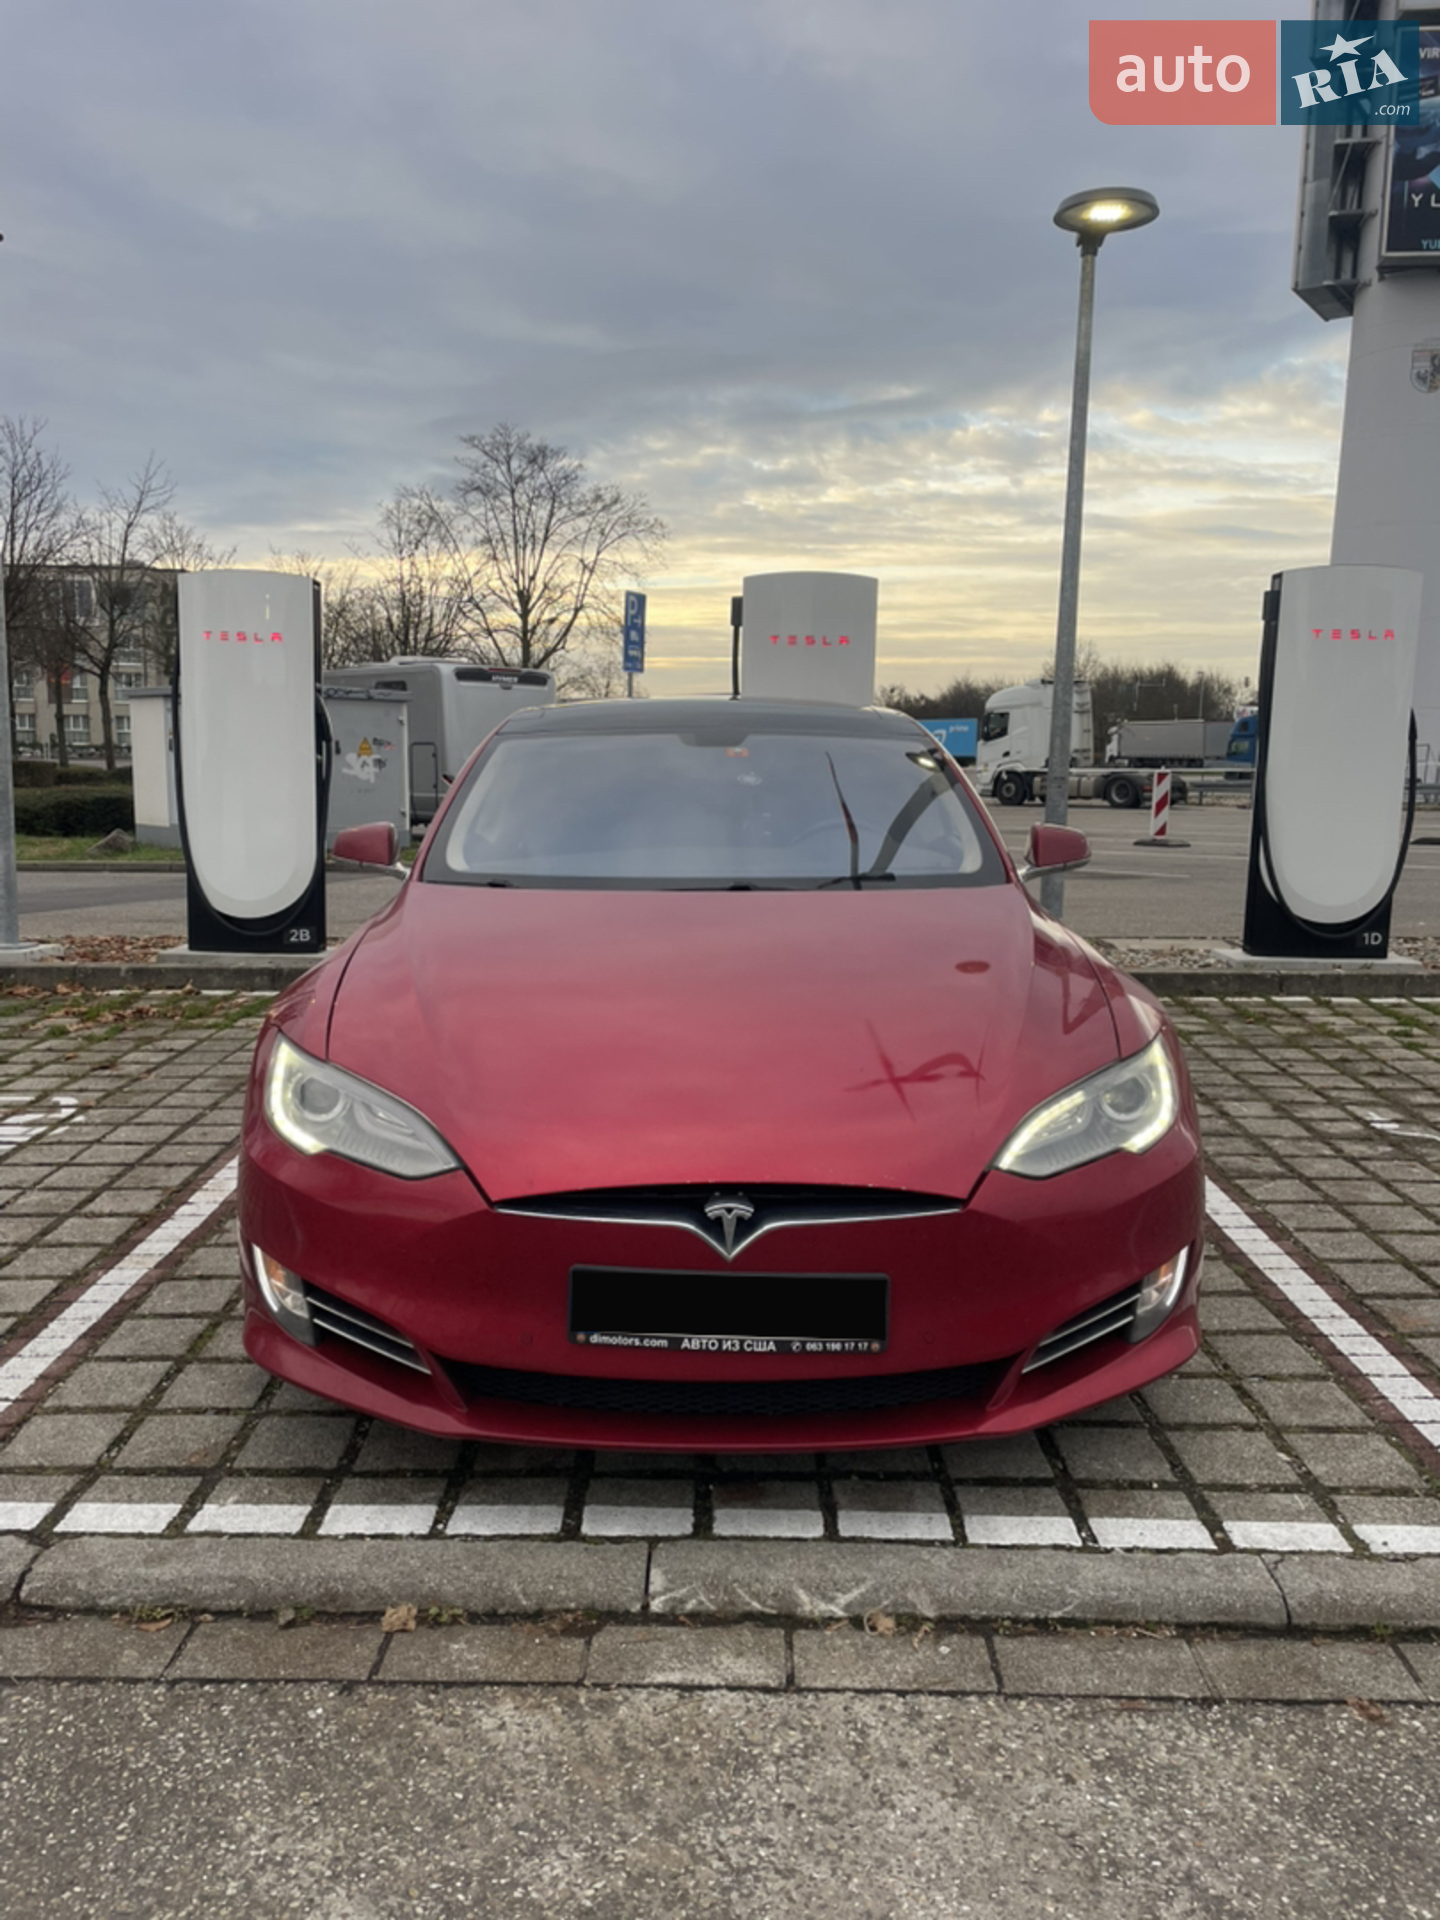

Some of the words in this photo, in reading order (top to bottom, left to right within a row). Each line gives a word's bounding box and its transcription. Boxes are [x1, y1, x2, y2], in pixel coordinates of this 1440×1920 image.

[202, 630, 284, 643] TESLA
[768, 635, 850, 648] TESLA
[1311, 628, 1395, 641] TESLA
[289, 928, 311, 942] 2B
[1362, 931, 1383, 945] 1D
[589, 1332, 669, 1348] dimotors.com
[680, 1338, 719, 1350] АВТО
[722, 1340, 740, 1351] ИЗ
[743, 1340, 777, 1352] США
